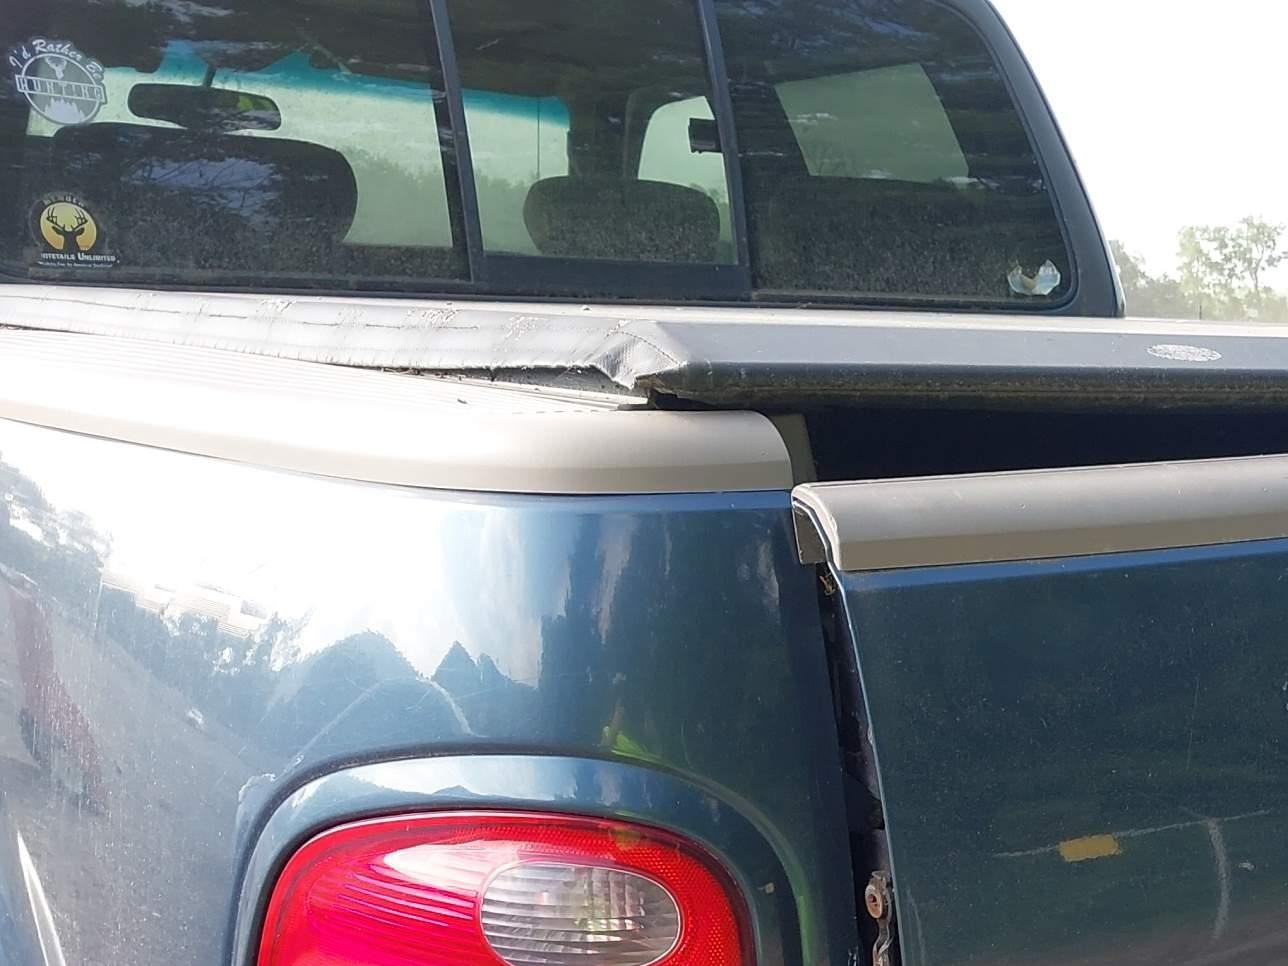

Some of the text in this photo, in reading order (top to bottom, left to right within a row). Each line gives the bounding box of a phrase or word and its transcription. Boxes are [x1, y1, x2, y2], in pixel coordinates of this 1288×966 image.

[32, 39, 82, 61] Rather
[86, 61, 103, 79] Be
[20, 76, 101, 100] HUNTING
